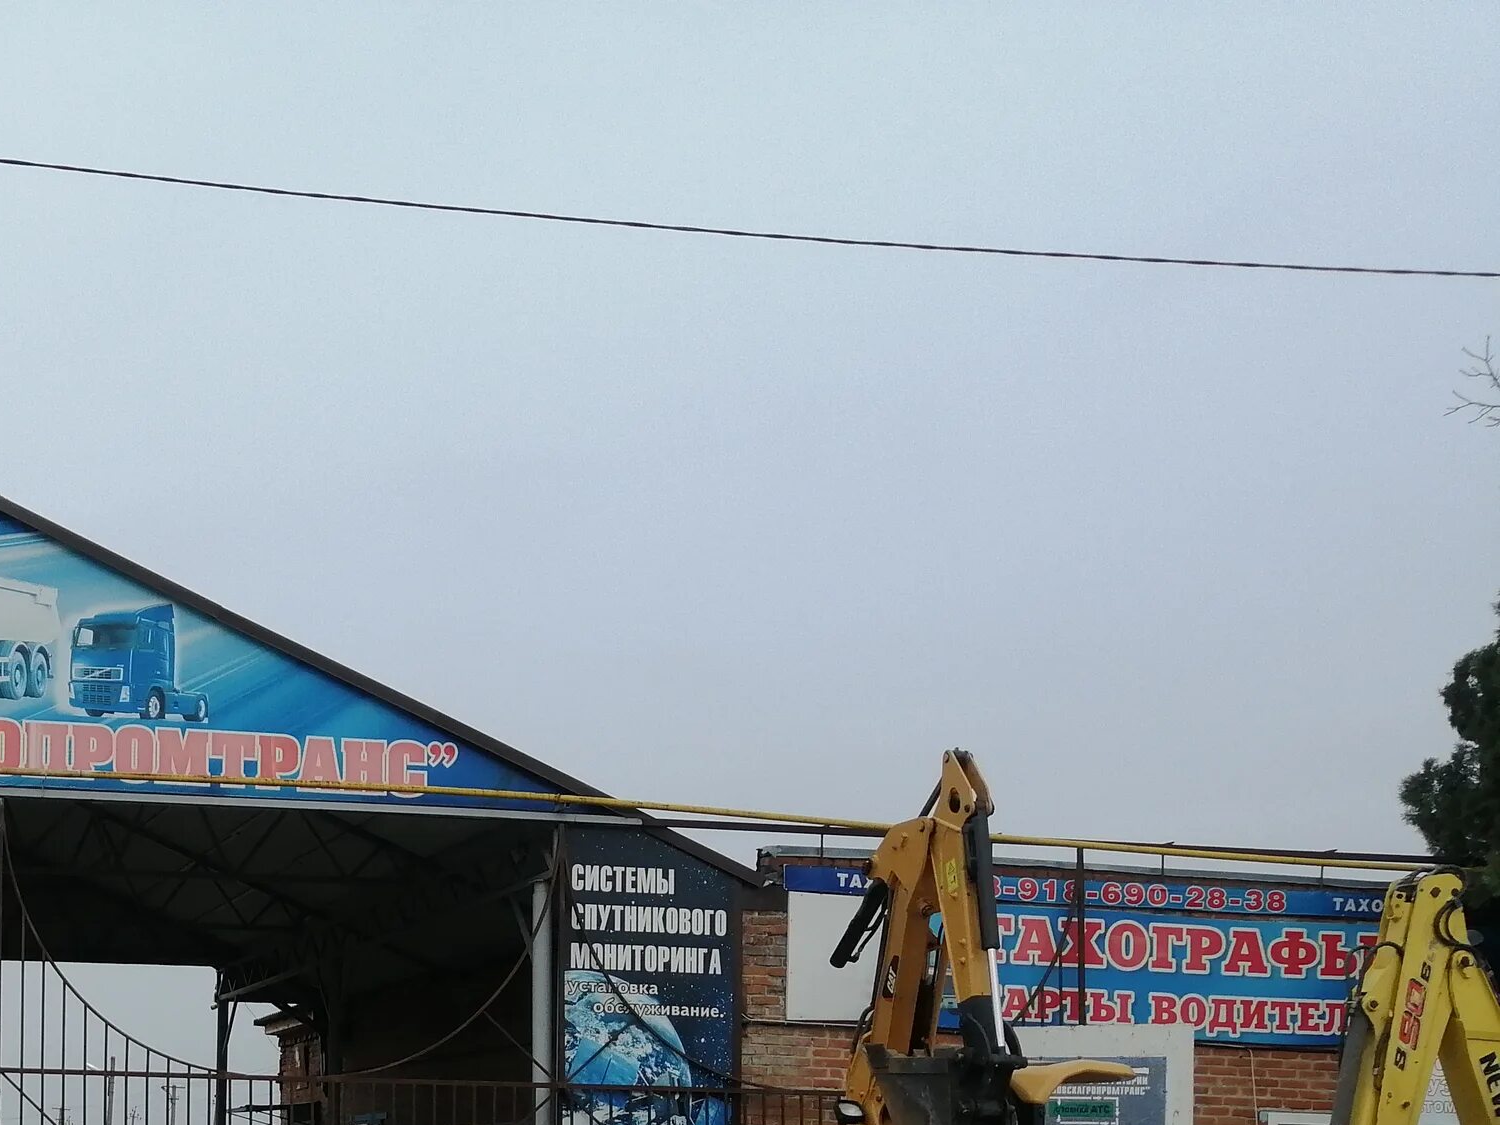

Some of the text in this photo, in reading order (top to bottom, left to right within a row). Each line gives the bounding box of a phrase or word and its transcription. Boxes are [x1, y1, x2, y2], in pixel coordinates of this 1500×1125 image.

[571, 863, 675, 895] СИСТЕМЫ
[571, 902, 727, 937] СПУТНИКОВОГО
[1333, 898, 1384, 913] ТАХО
[570, 942, 722, 975] МОНИТОРИНГА
[886, 965, 897, 994] CAT
[999, 986, 1350, 1036] АРТЫ ВОДИТЕЛ
